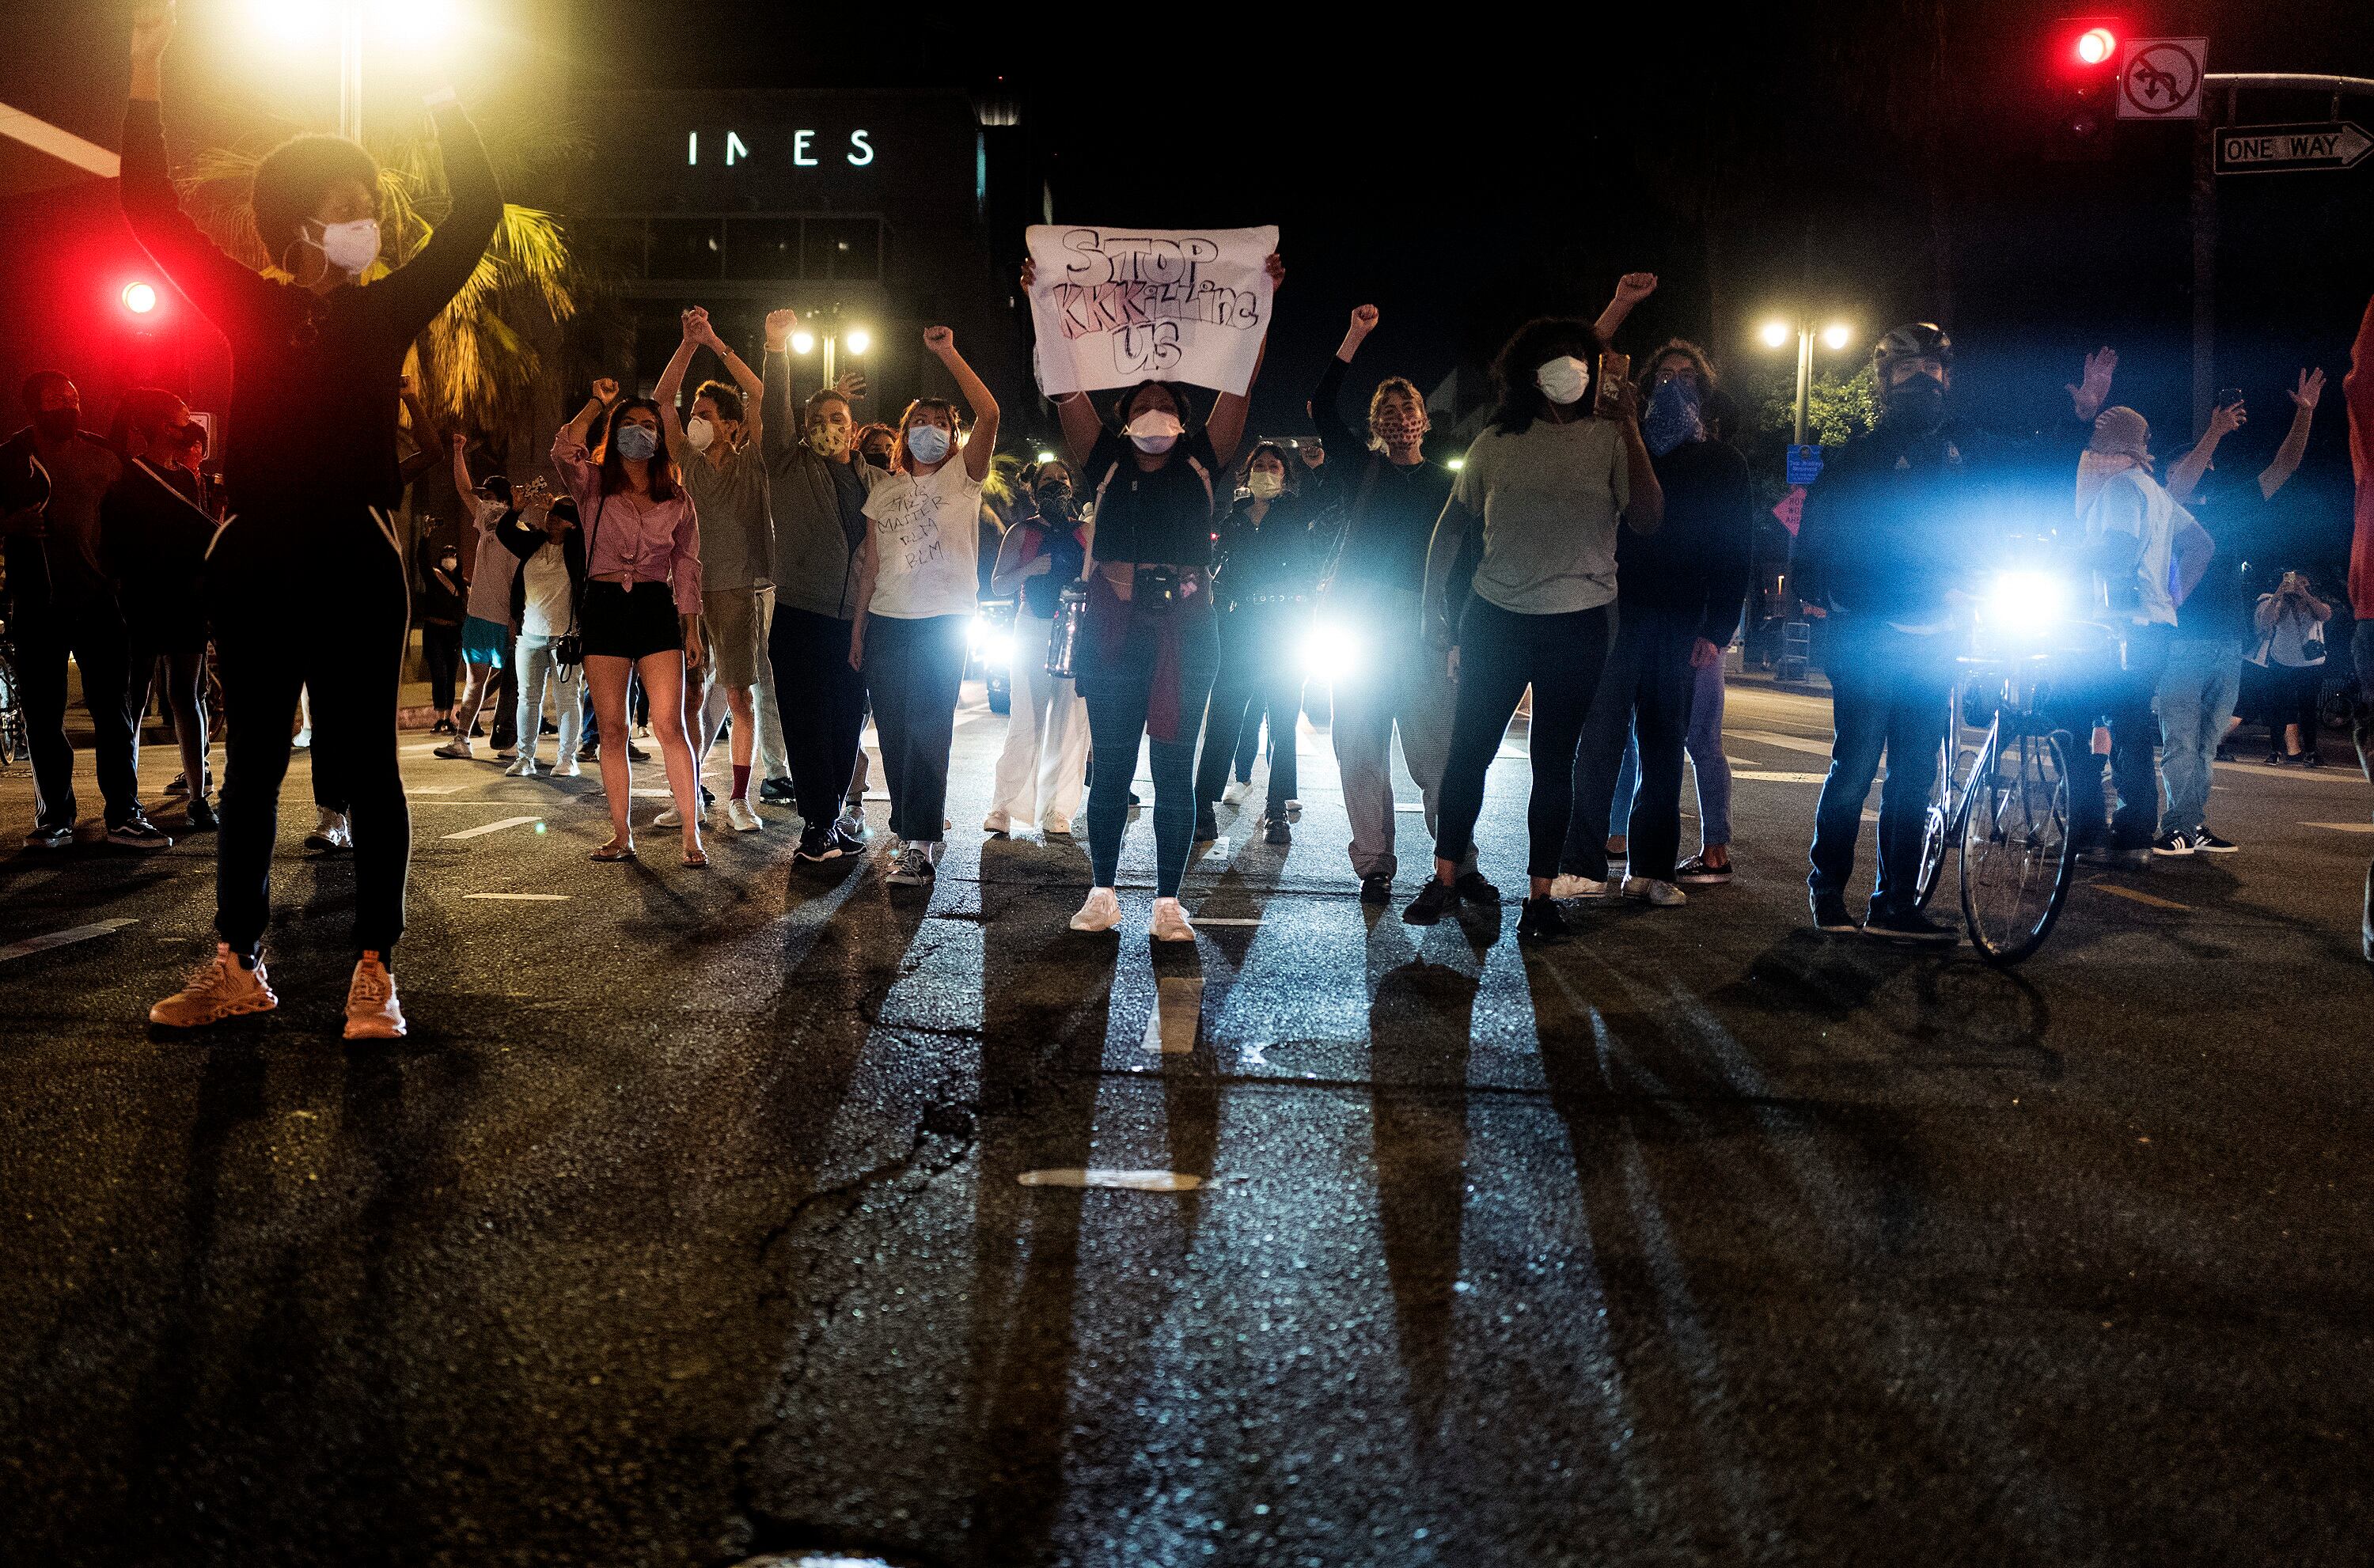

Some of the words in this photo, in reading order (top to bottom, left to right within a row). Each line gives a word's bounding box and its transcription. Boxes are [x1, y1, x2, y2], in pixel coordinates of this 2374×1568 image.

[2228, 139, 2274, 159] ONE
[2291, 135, 2340, 157] WAY
[1062, 229, 1219, 287] STOP
[1112, 320, 1181, 374] US
[905, 540, 944, 569] BLM
